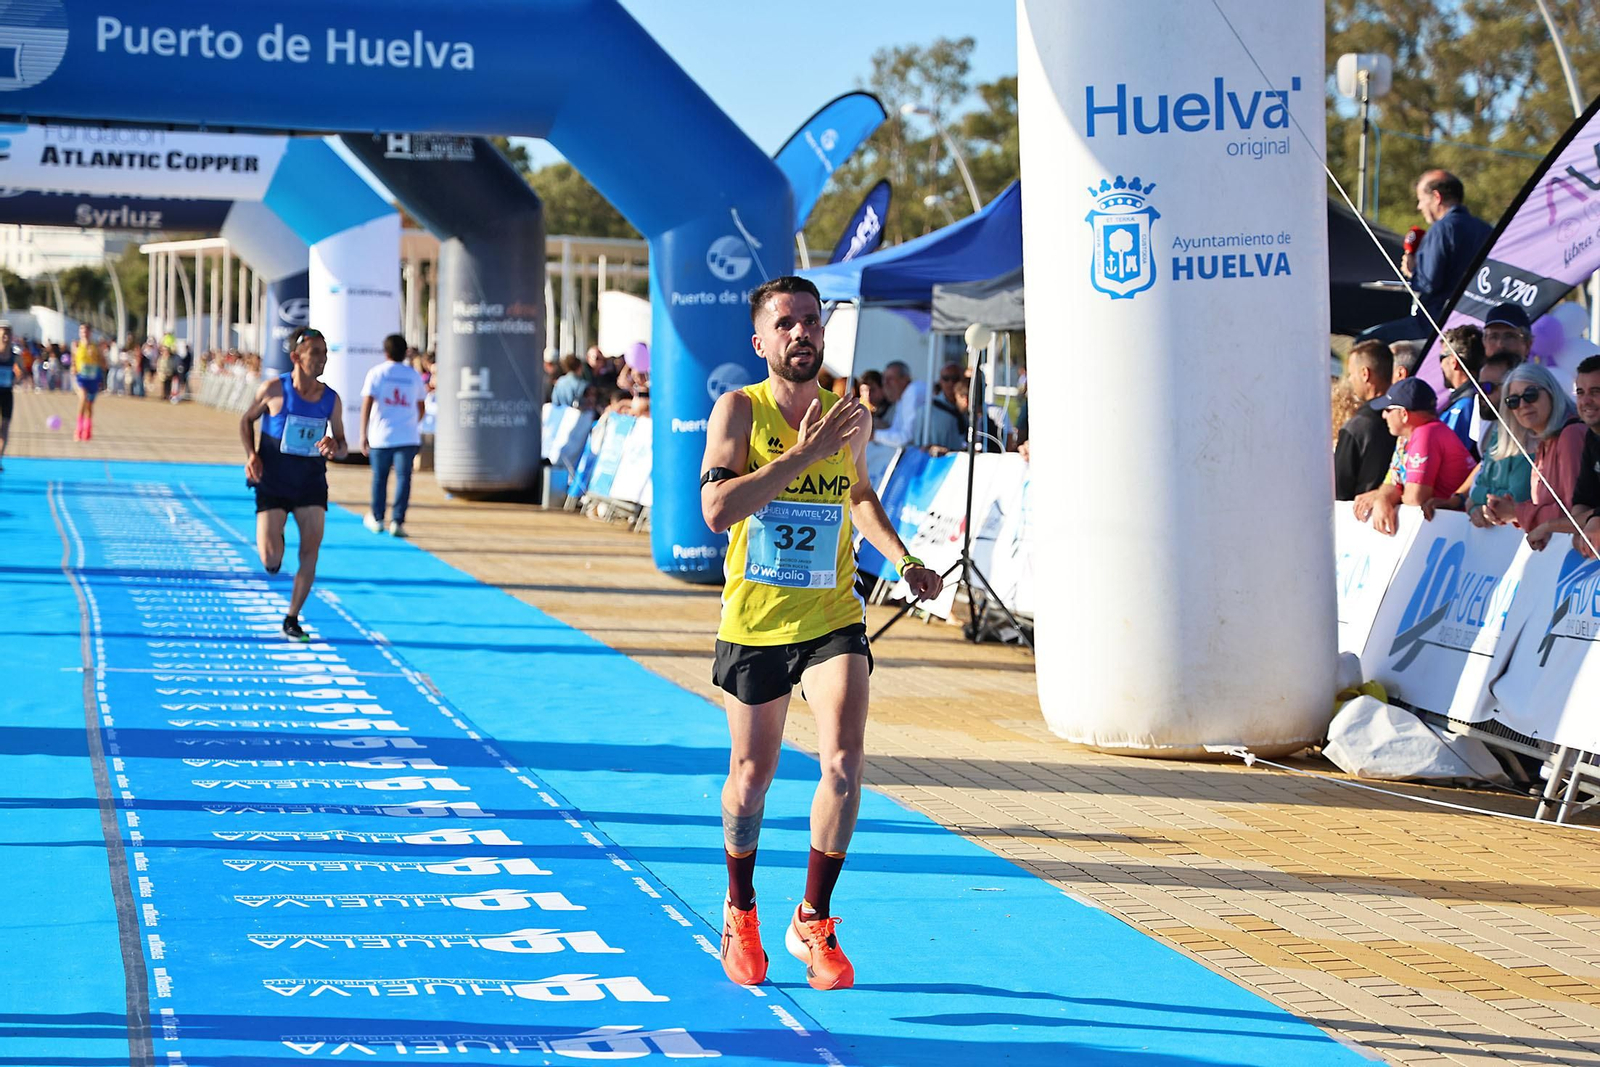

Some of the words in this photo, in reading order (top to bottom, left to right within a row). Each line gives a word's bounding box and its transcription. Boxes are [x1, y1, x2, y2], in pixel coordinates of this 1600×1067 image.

[96, 15, 243, 60] Puerto
[256, 23, 311, 63] de
[326, 28, 475, 70] Huelva
[1085, 76, 1291, 138] Huelva
[1226, 136, 1291, 160] original
[40, 146, 160, 170] ATLANTIC
[166, 150, 260, 172] COPPER
[1172, 235, 1275, 253] Ayuntamiento
[1276, 231, 1292, 245] de
[1172, 252, 1292, 281] HUELVA
[671, 291, 717, 306] Puerto
[719, 289, 739, 305] de
[299, 428, 315, 440] 16
[773, 524, 817, 552] 32
[672, 544, 719, 559] Puerto
[761, 565, 805, 581] Wayalia
[223, 861, 427, 872] HUELVA
[234, 898, 452, 908] HUELVA
[248, 937, 482, 949] HUELVA
[263, 982, 514, 997] HUELVA
[282, 1039, 557, 1056] HUELVA
